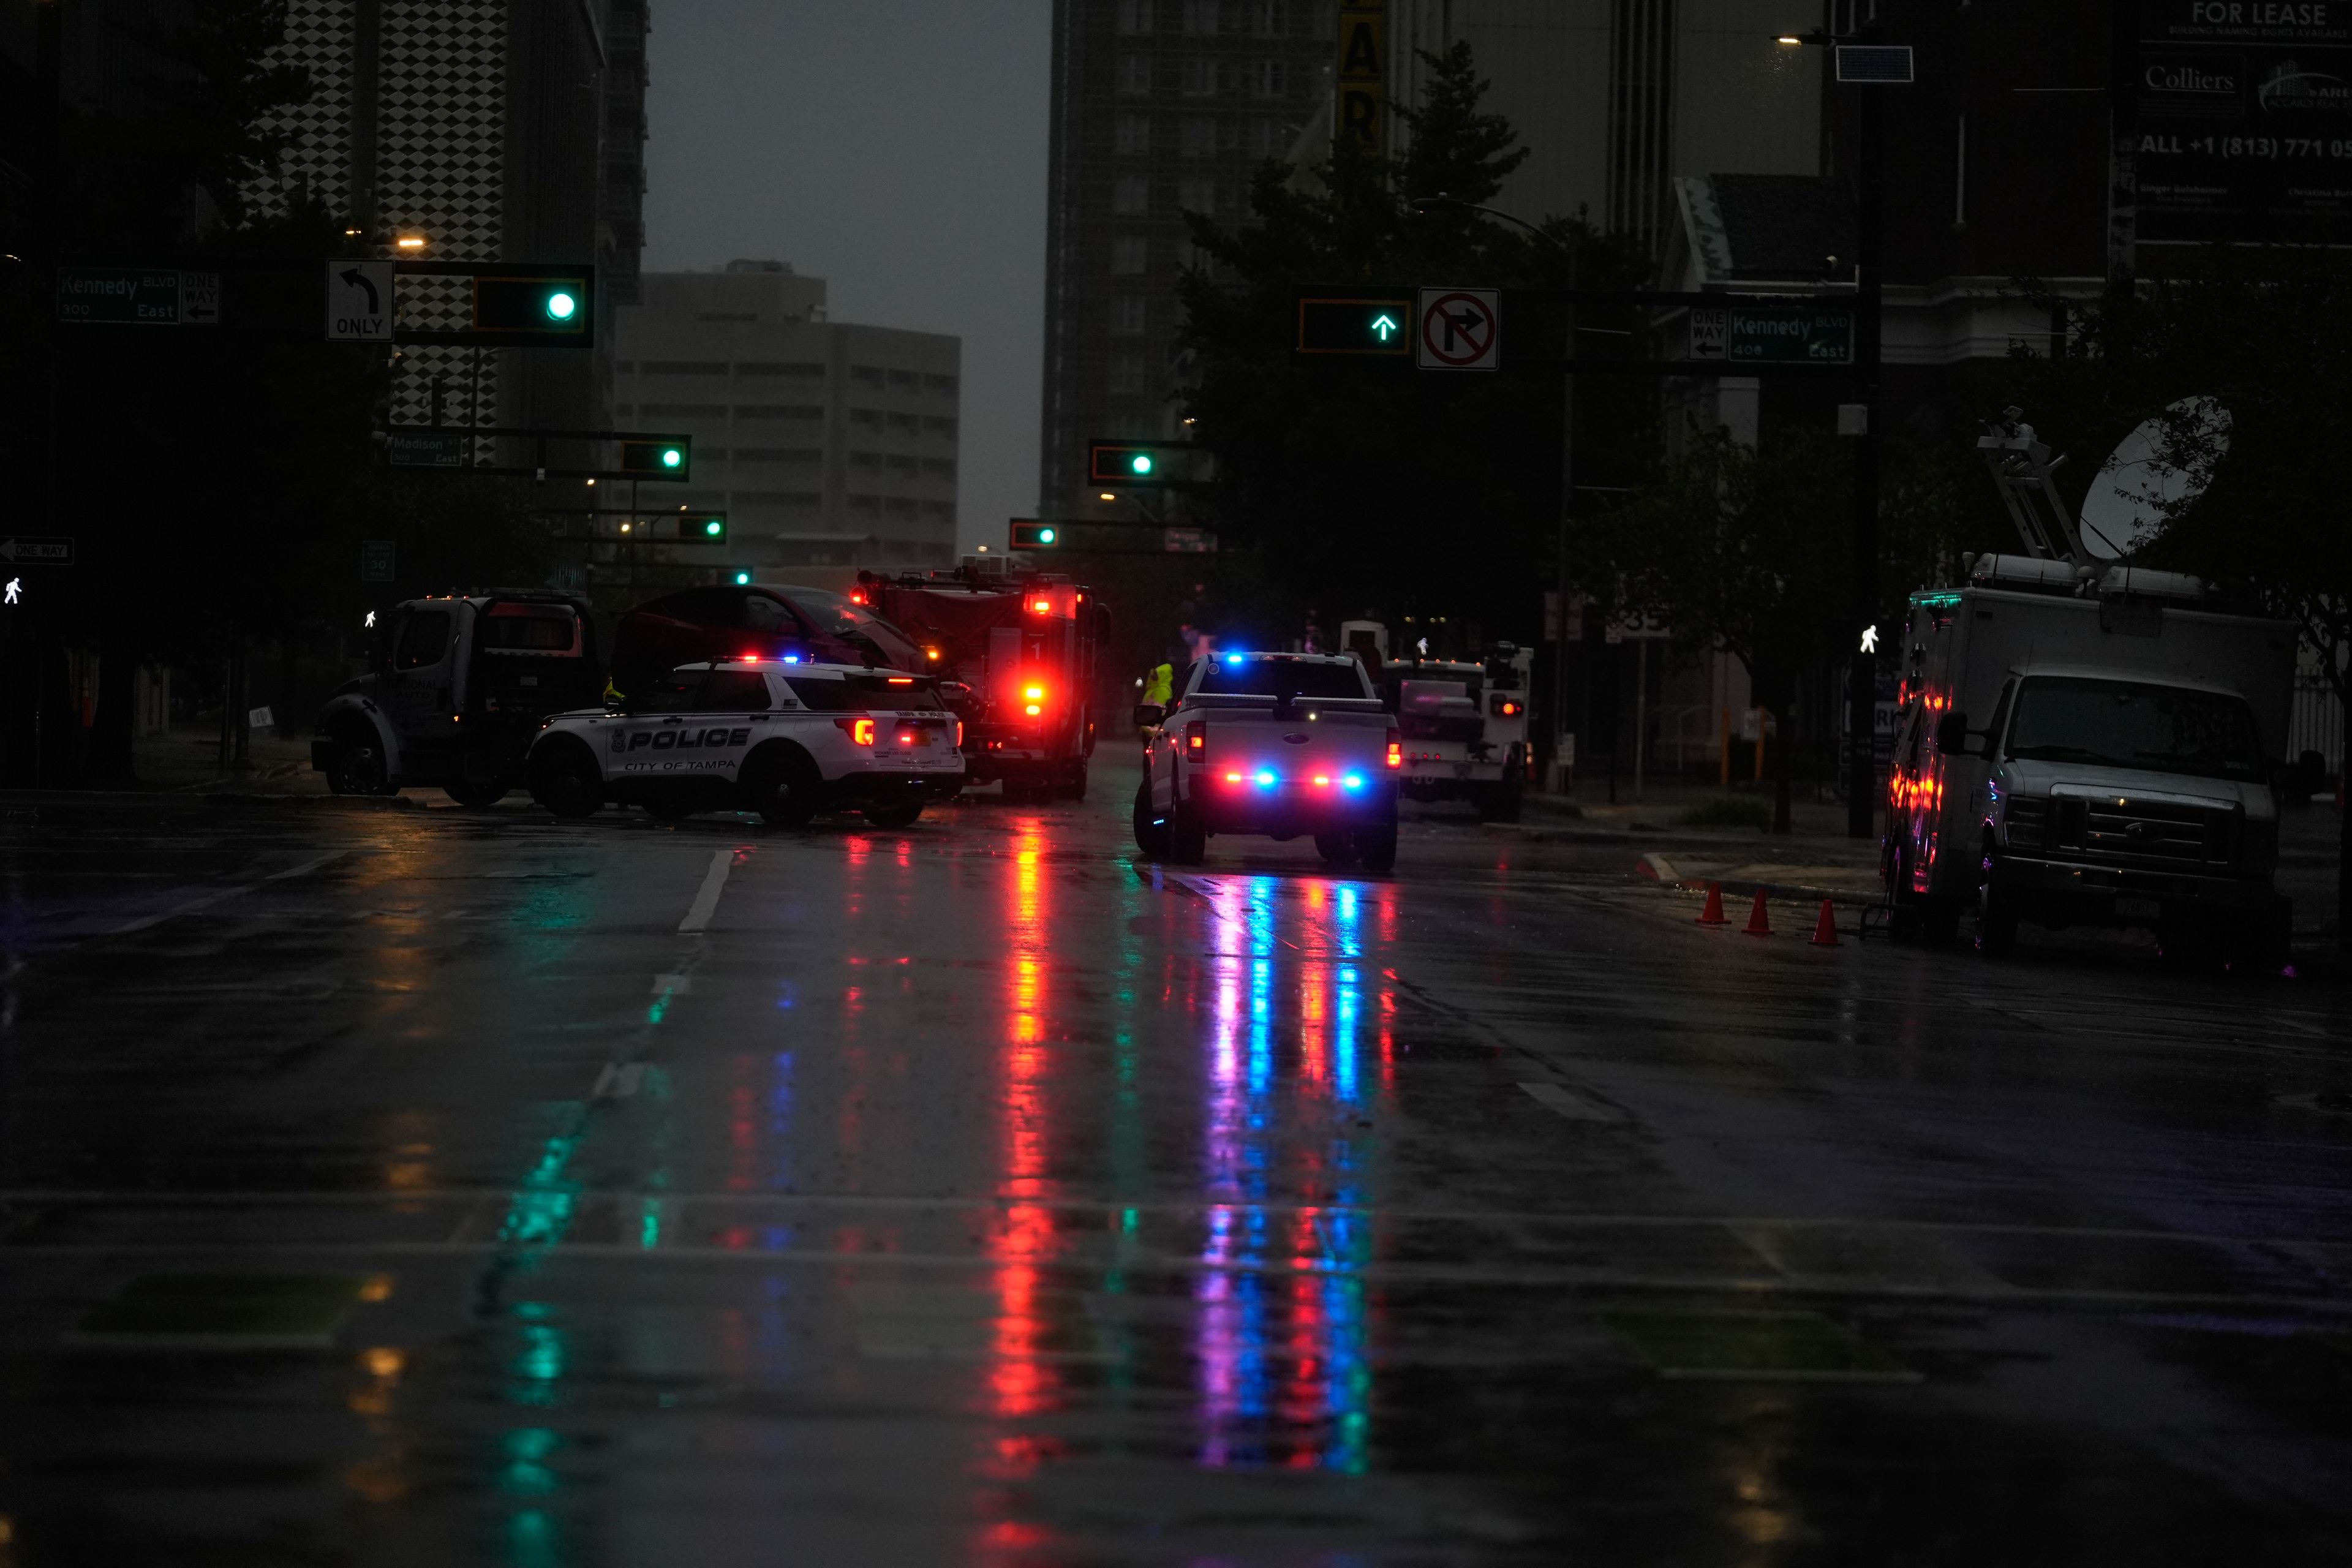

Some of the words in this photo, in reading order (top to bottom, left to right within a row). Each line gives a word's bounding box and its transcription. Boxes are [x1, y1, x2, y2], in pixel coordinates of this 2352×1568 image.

[2193, 1, 2242, 23] FOR
[2253, 3, 2326, 25] LEASE
[2169, 26, 2214, 34] BUILDING
[2216, 26, 2258, 36] NAMING
[2261, 28, 2293, 37] RIGHTS
[2296, 28, 2348, 39] AVAILABLE
[2145, 65, 2234, 89] Colliers
[2137, 134, 2183, 153] ALL
[2190, 137, 2213, 154] +1
[2220, 137, 2278, 160] (813)
[2285, 138, 2323, 157] 771
[61, 275, 137, 301] Kennedy
[143, 277, 175, 288] BLVD
[186, 275, 216, 288] ONE
[185, 290, 217, 303] WAY
[62, 304, 90, 315] 300
[137, 304, 174, 318] East
[1694, 312, 1724, 325] ONE
[337, 318, 383, 334] ONLY
[1693, 326, 1724, 339] WAY
[1733, 315, 1812, 341] Kennedy
[1815, 317, 1847, 328] BLVD
[1734, 344, 1763, 356] 400
[1809, 343, 1845, 357] East
[393, 437, 443, 450] Madison
[16, 545, 37, 556] ONE
[41, 546, 64, 556] WAY
[371, 559, 386, 570] 30
[1031, 642, 1041, 660] 1
[387, 680, 438, 690] NATIONAL
[627, 728, 753, 751] POLICE
[688, 760, 736, 769] TAMPA
